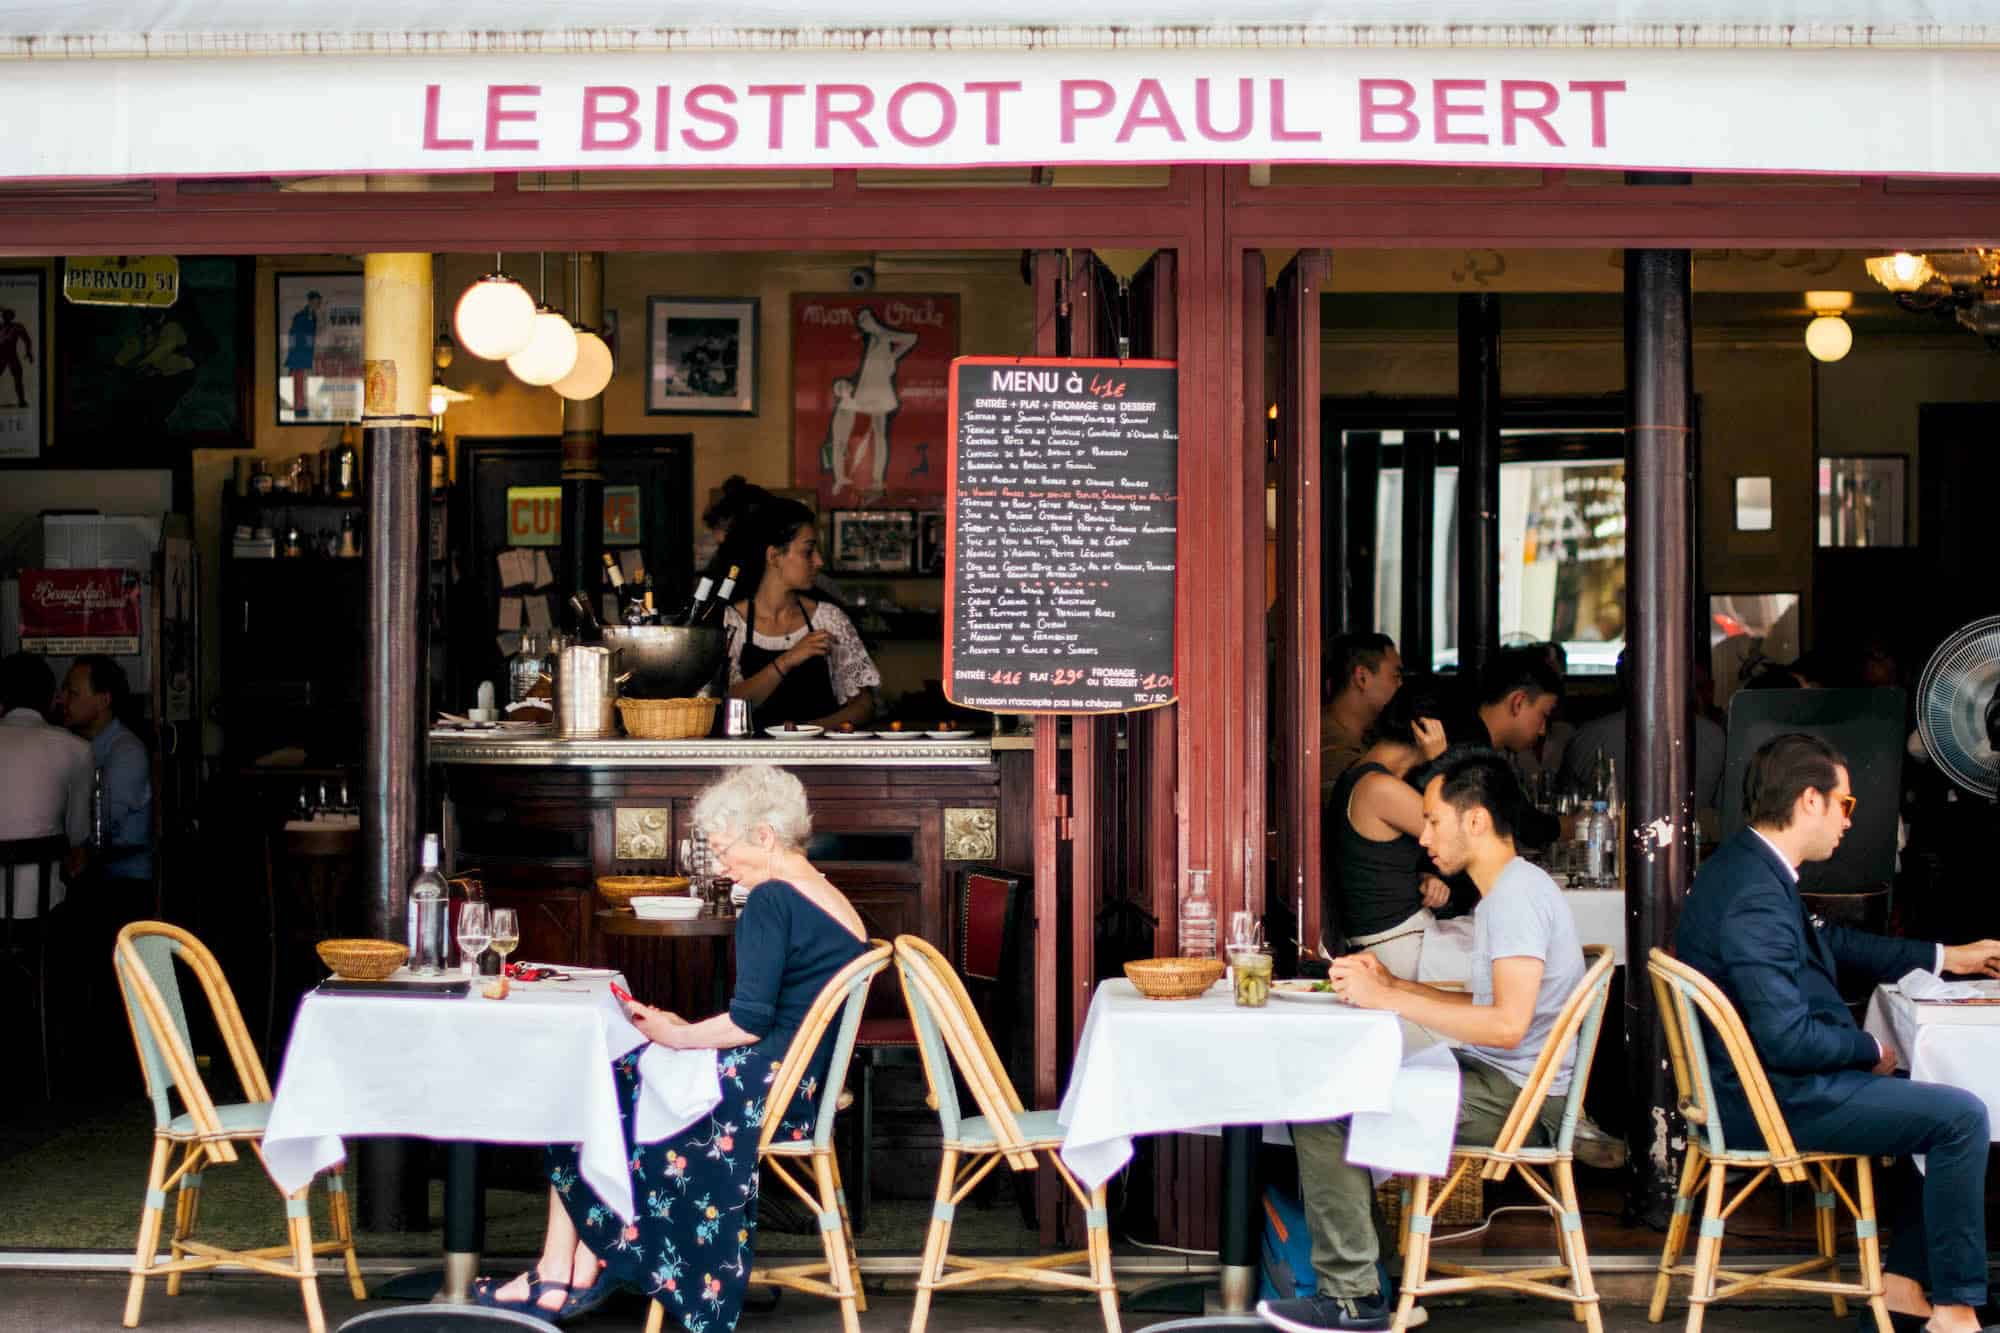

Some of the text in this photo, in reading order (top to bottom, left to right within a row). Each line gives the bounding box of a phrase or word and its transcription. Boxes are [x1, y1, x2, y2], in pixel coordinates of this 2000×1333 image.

[424, 80, 1626, 152] LE BISTROT PAUL BERT
[68, 269, 147, 289] PERNOD
[992, 370, 1060, 392] MENU
[1065, 371, 1083, 393] à
[975, 398, 1008, 409] ENTRÉE
[1019, 400, 1041, 410] PLAT
[1052, 401, 1099, 411] FROMAGE
[1119, 402, 1157, 412] DESSERT
[511, 496, 635, 537] CUINE
[1091, 668, 1137, 678] FROMAGE
[1103, 678, 1139, 688] DESSERT
[964, 696, 1123, 710] La maison n'accepte pas les chèques
